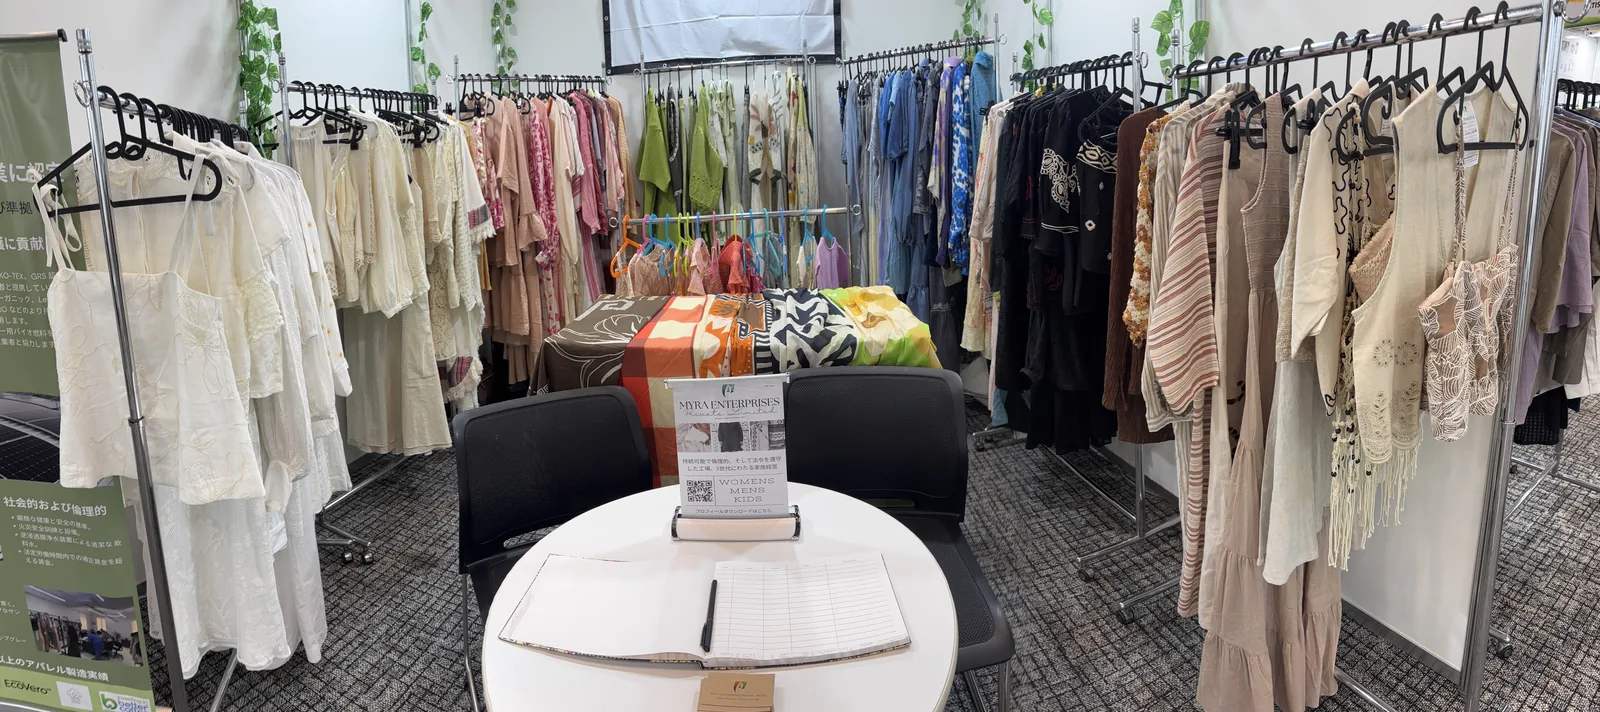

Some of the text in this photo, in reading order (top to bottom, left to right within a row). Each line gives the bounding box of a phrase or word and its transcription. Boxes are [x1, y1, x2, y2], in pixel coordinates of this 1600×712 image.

[679, 397, 780, 410] MYRA ENTERPRISES
[718, 477, 775, 486] WOMENS
[730, 487, 766, 495] MENS
[3, 496, 107, 517] 社会的および倫理的
[118, 699, 148, 711] better
